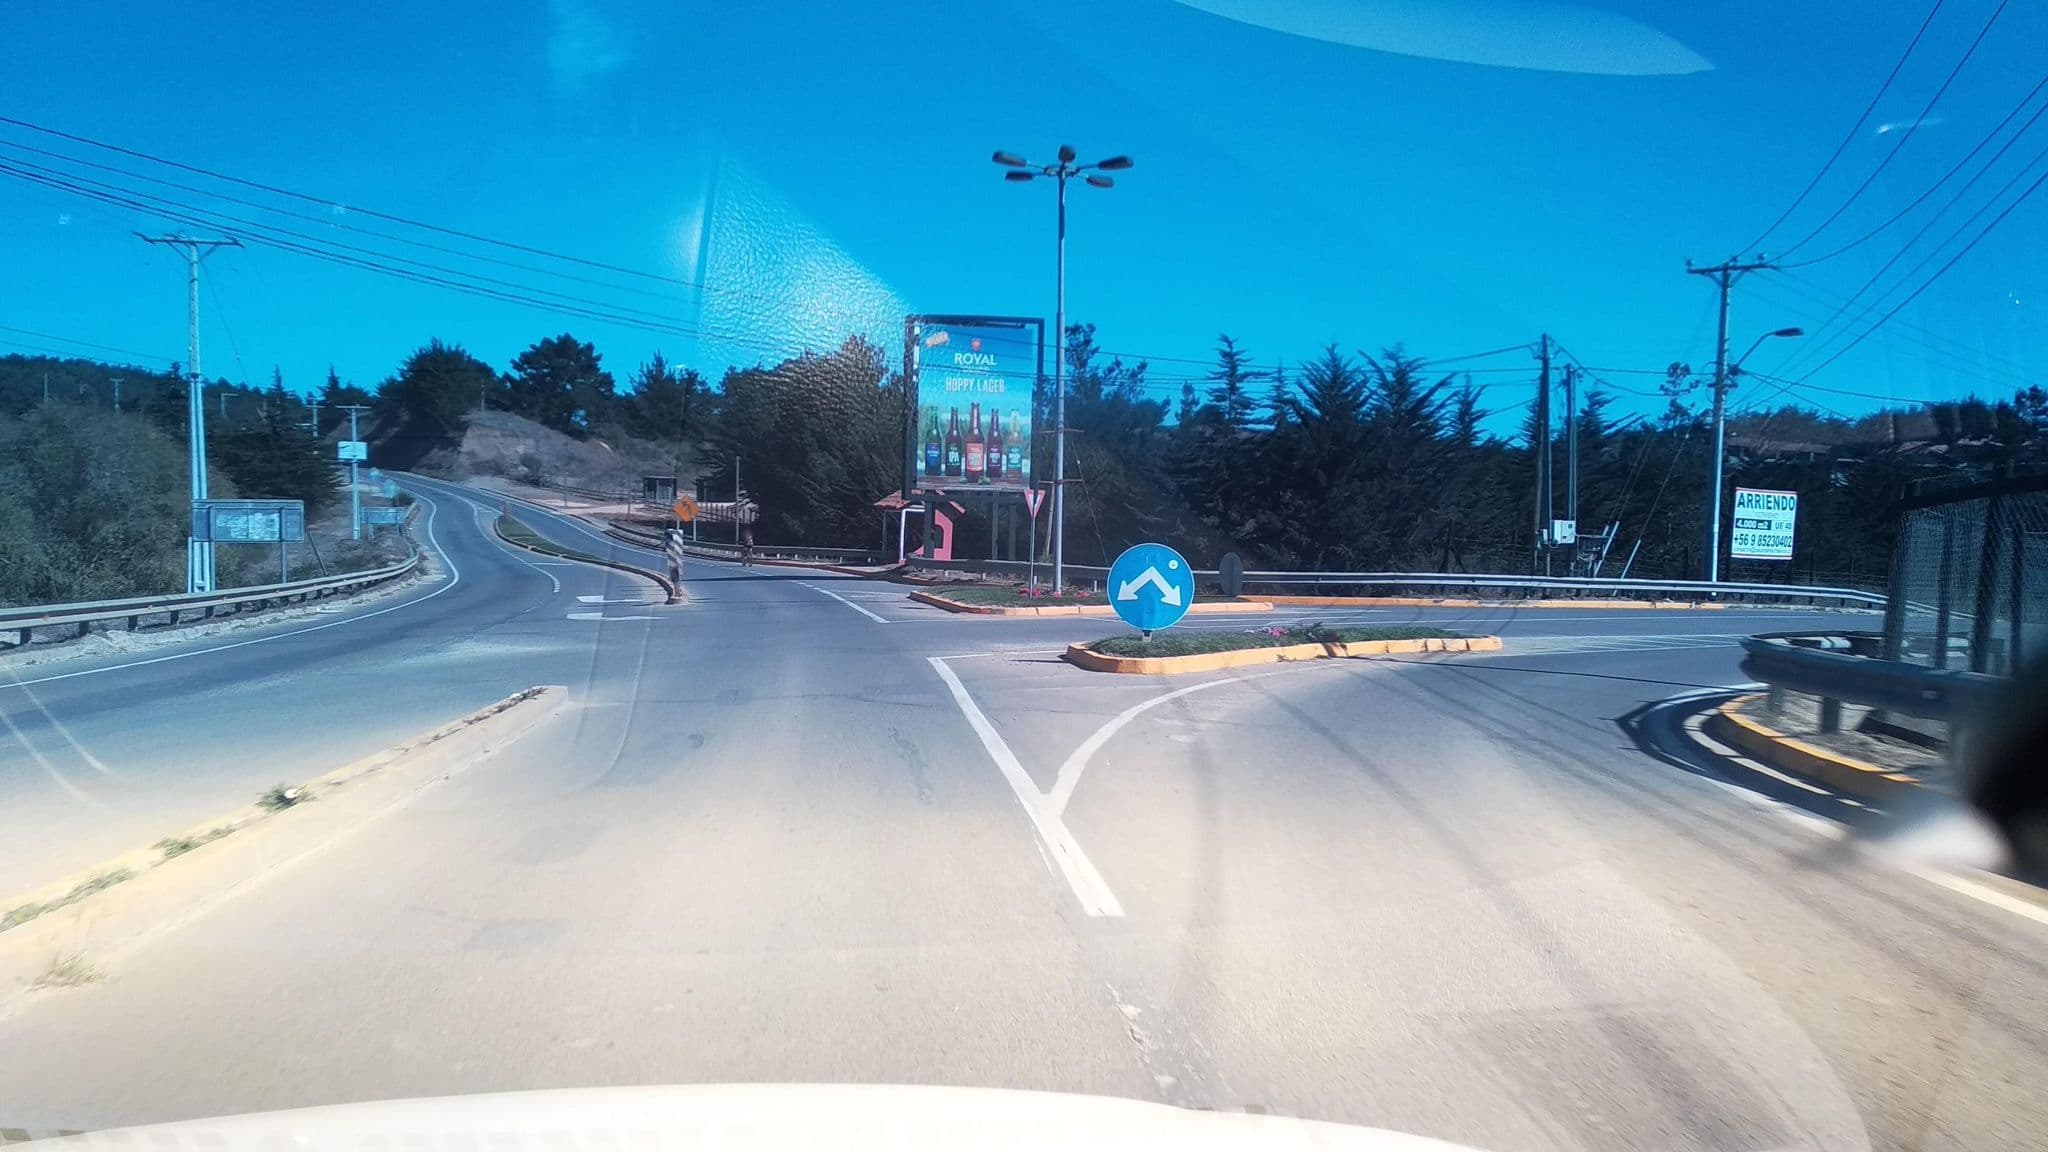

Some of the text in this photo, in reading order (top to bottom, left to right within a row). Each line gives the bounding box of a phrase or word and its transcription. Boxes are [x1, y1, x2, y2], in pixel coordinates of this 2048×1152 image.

[954, 352, 998, 366] ROYAL
[945, 376, 1005, 393] HOPPY LAGER
[1737, 493, 1795, 511] ARRIENDO
[1736, 520, 1769, 529] 4.000 m2
[1775, 522, 1784, 530] UF
[1734, 533, 1792, 548] +56 9 85230402
